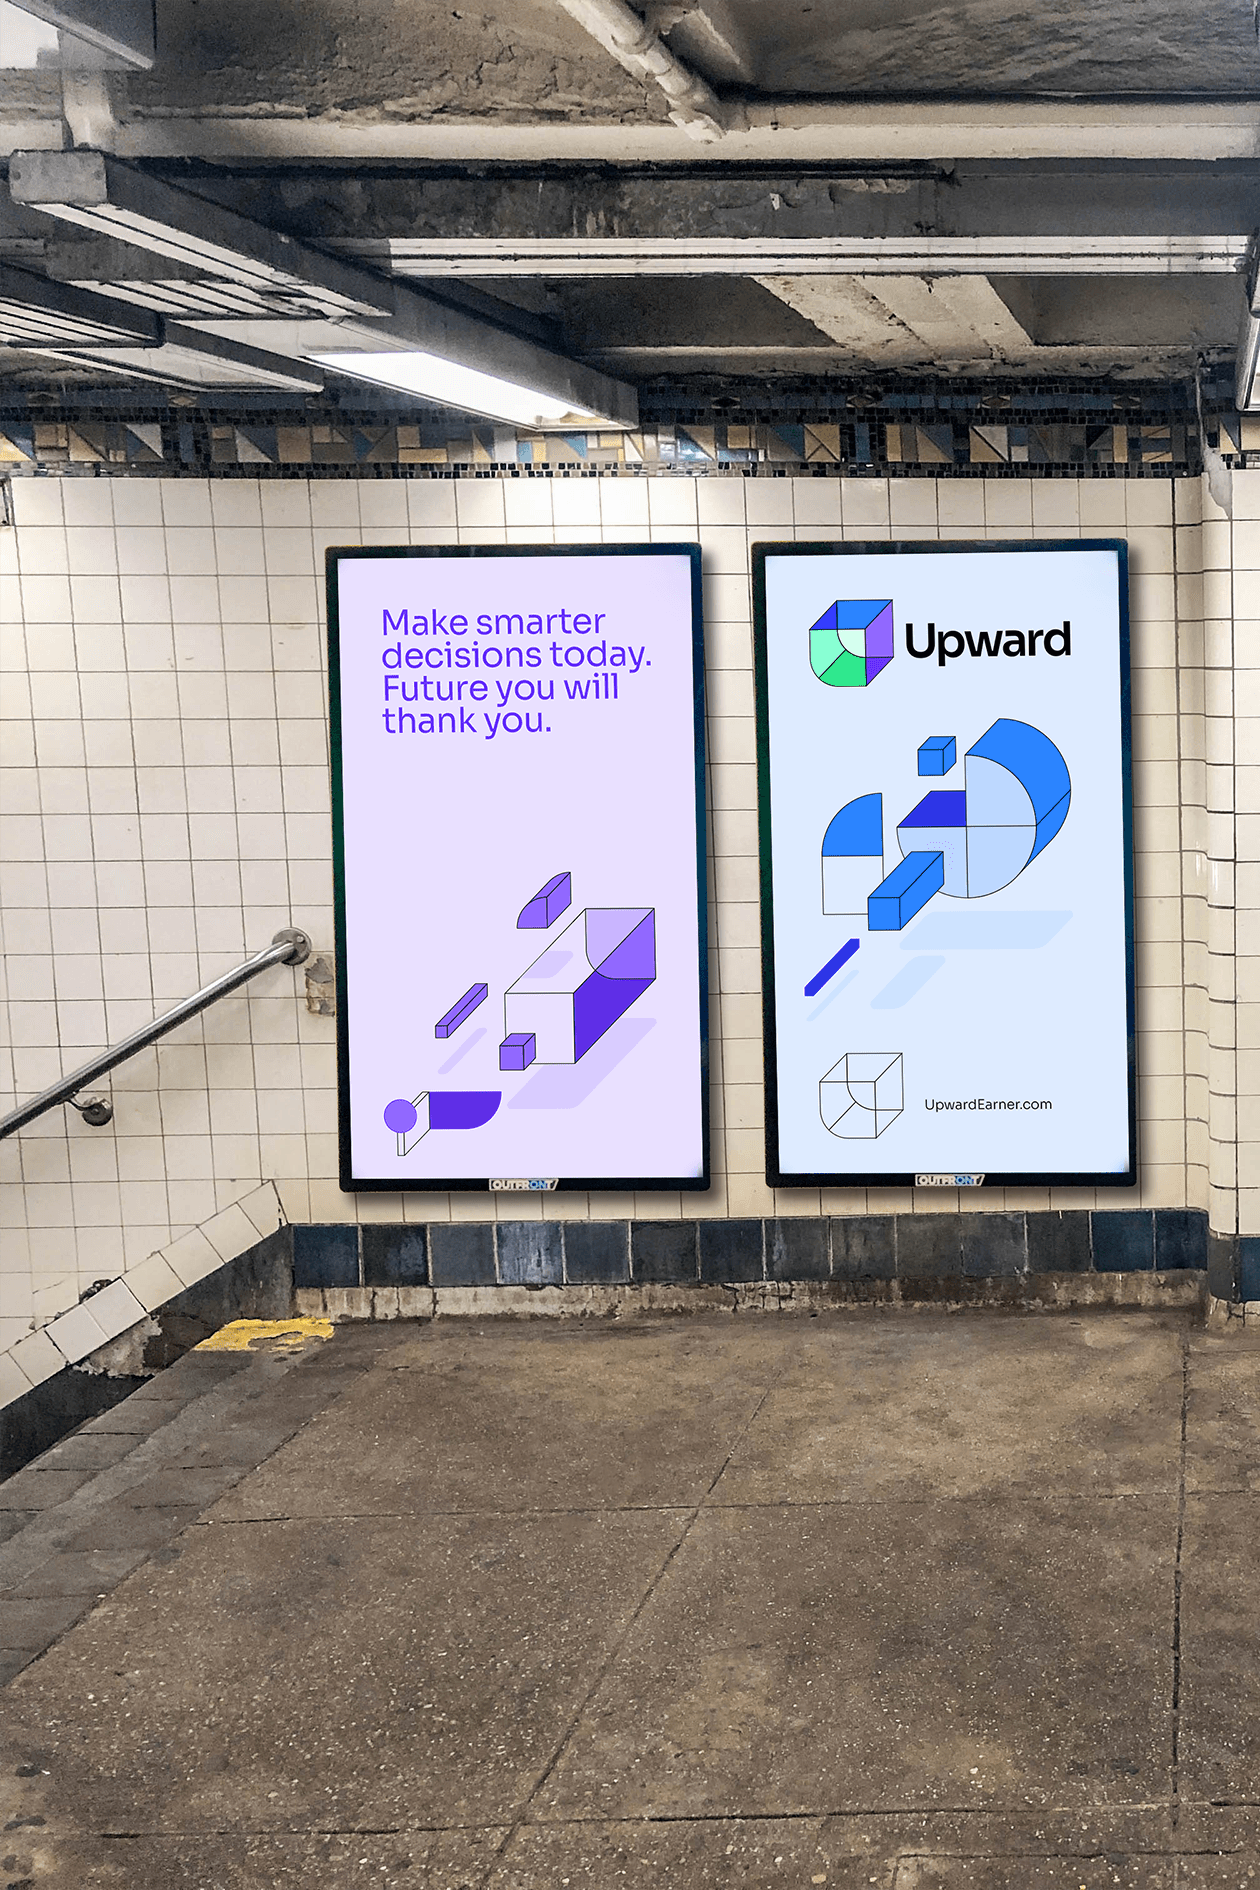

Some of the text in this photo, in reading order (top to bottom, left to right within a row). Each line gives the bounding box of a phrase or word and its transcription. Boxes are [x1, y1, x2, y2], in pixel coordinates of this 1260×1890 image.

[382, 608, 606, 636] Make smarter
[381, 640, 652, 673] decisions today.
[905, 620, 1072, 667] Upward
[384, 672, 619, 708] Future you will
[382, 706, 552, 740] thank you.
[924, 1098, 1053, 1113] UpwardEarner.com
[492, 1180, 553, 1189] OUTFRONT
[919, 1176, 979, 1185] OUTFRONT
